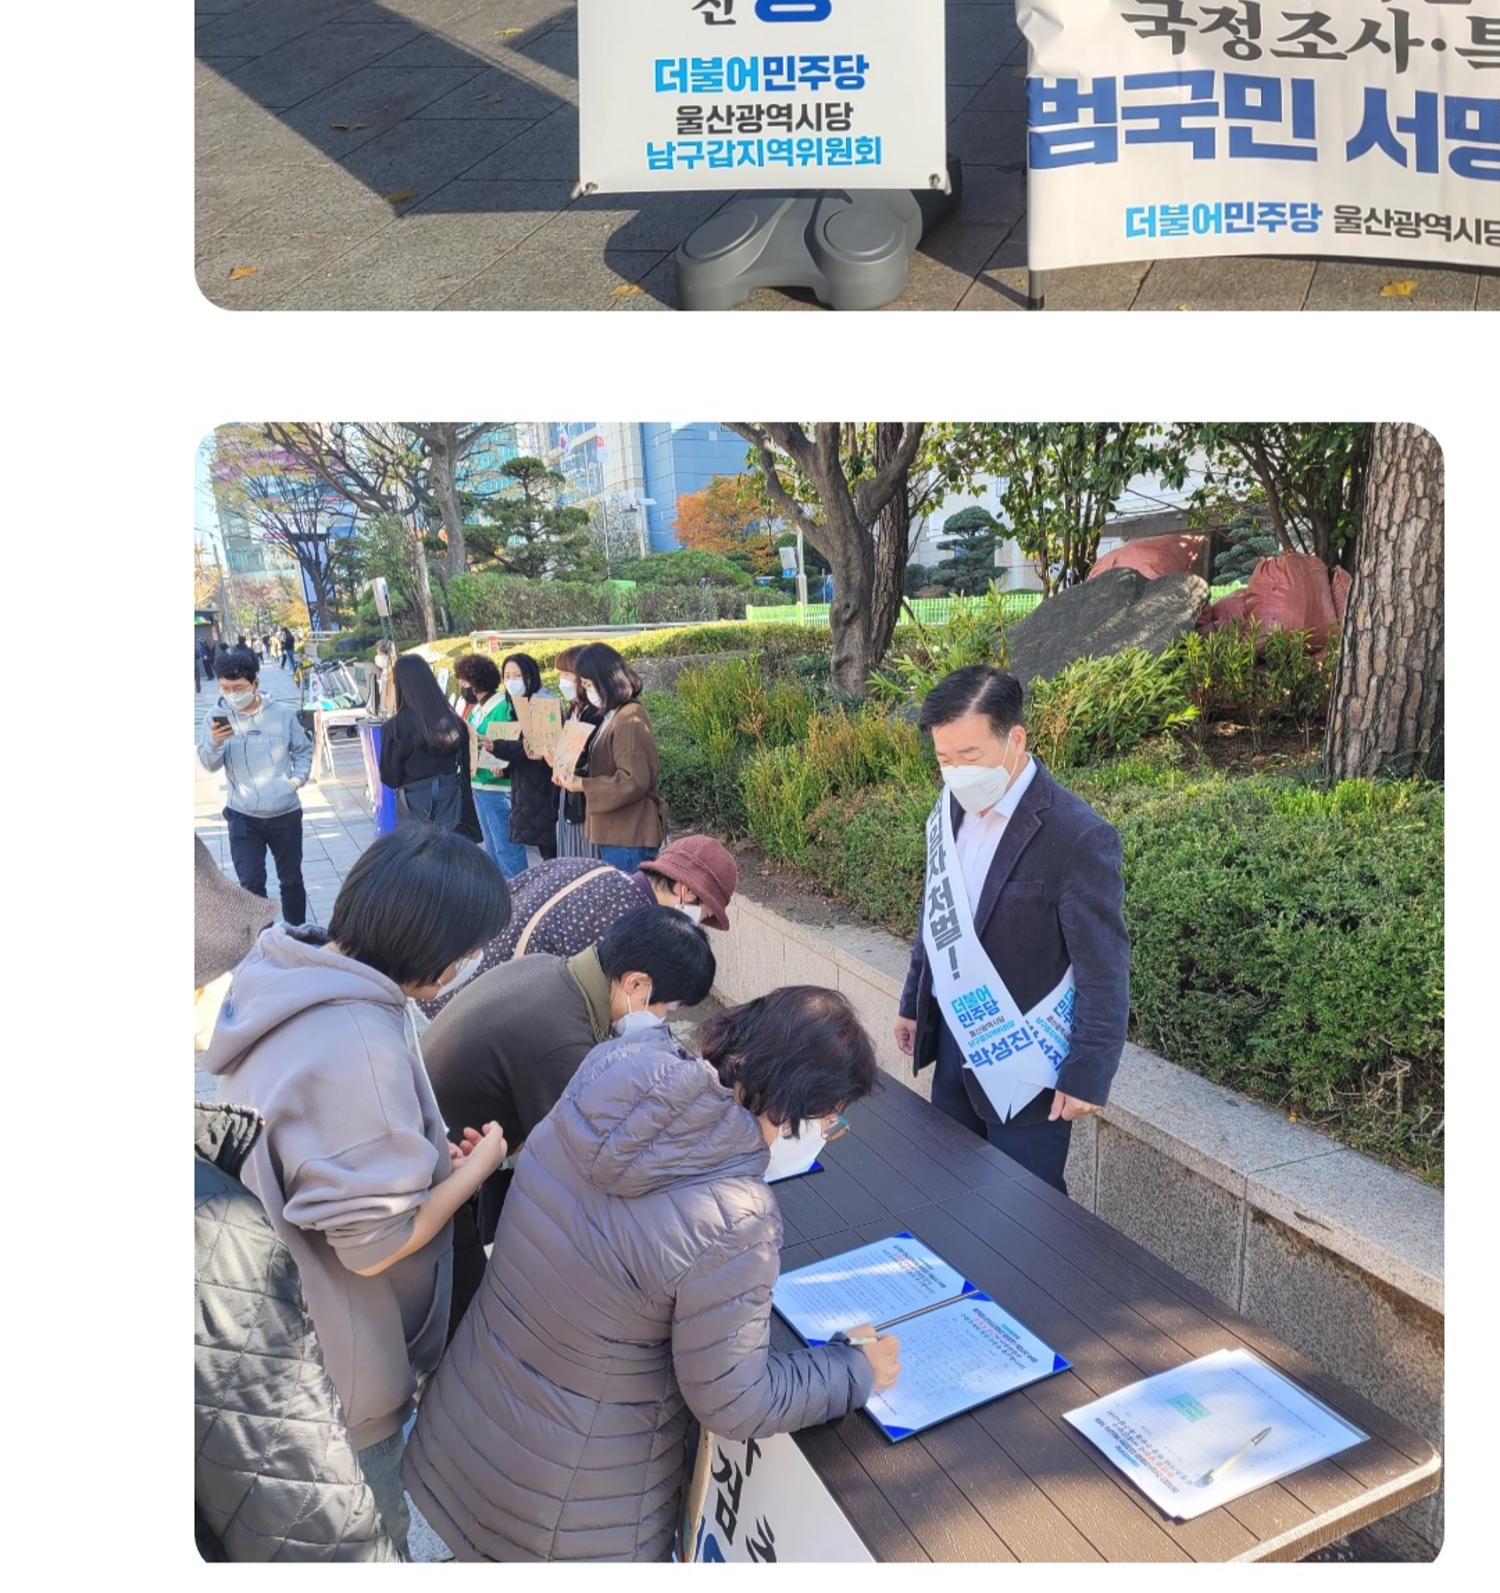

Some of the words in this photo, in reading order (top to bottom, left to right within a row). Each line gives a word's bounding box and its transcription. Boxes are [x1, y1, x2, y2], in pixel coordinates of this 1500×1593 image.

[654, 54, 870, 94] 더불어민주당
[675, 101, 854, 136] 울산광역시당
[1028, 72, 1318, 172] 범국민
[646, 136, 883, 171] 남구갑지역위원회
[1124, 202, 1324, 240] 더불어민주당
[926, 877, 964, 982] 처벌!
[950, 983, 993, 1015] 더불어
[957, 997, 1001, 1029] 민주당
[967, 1025, 1035, 1069] 박성진
